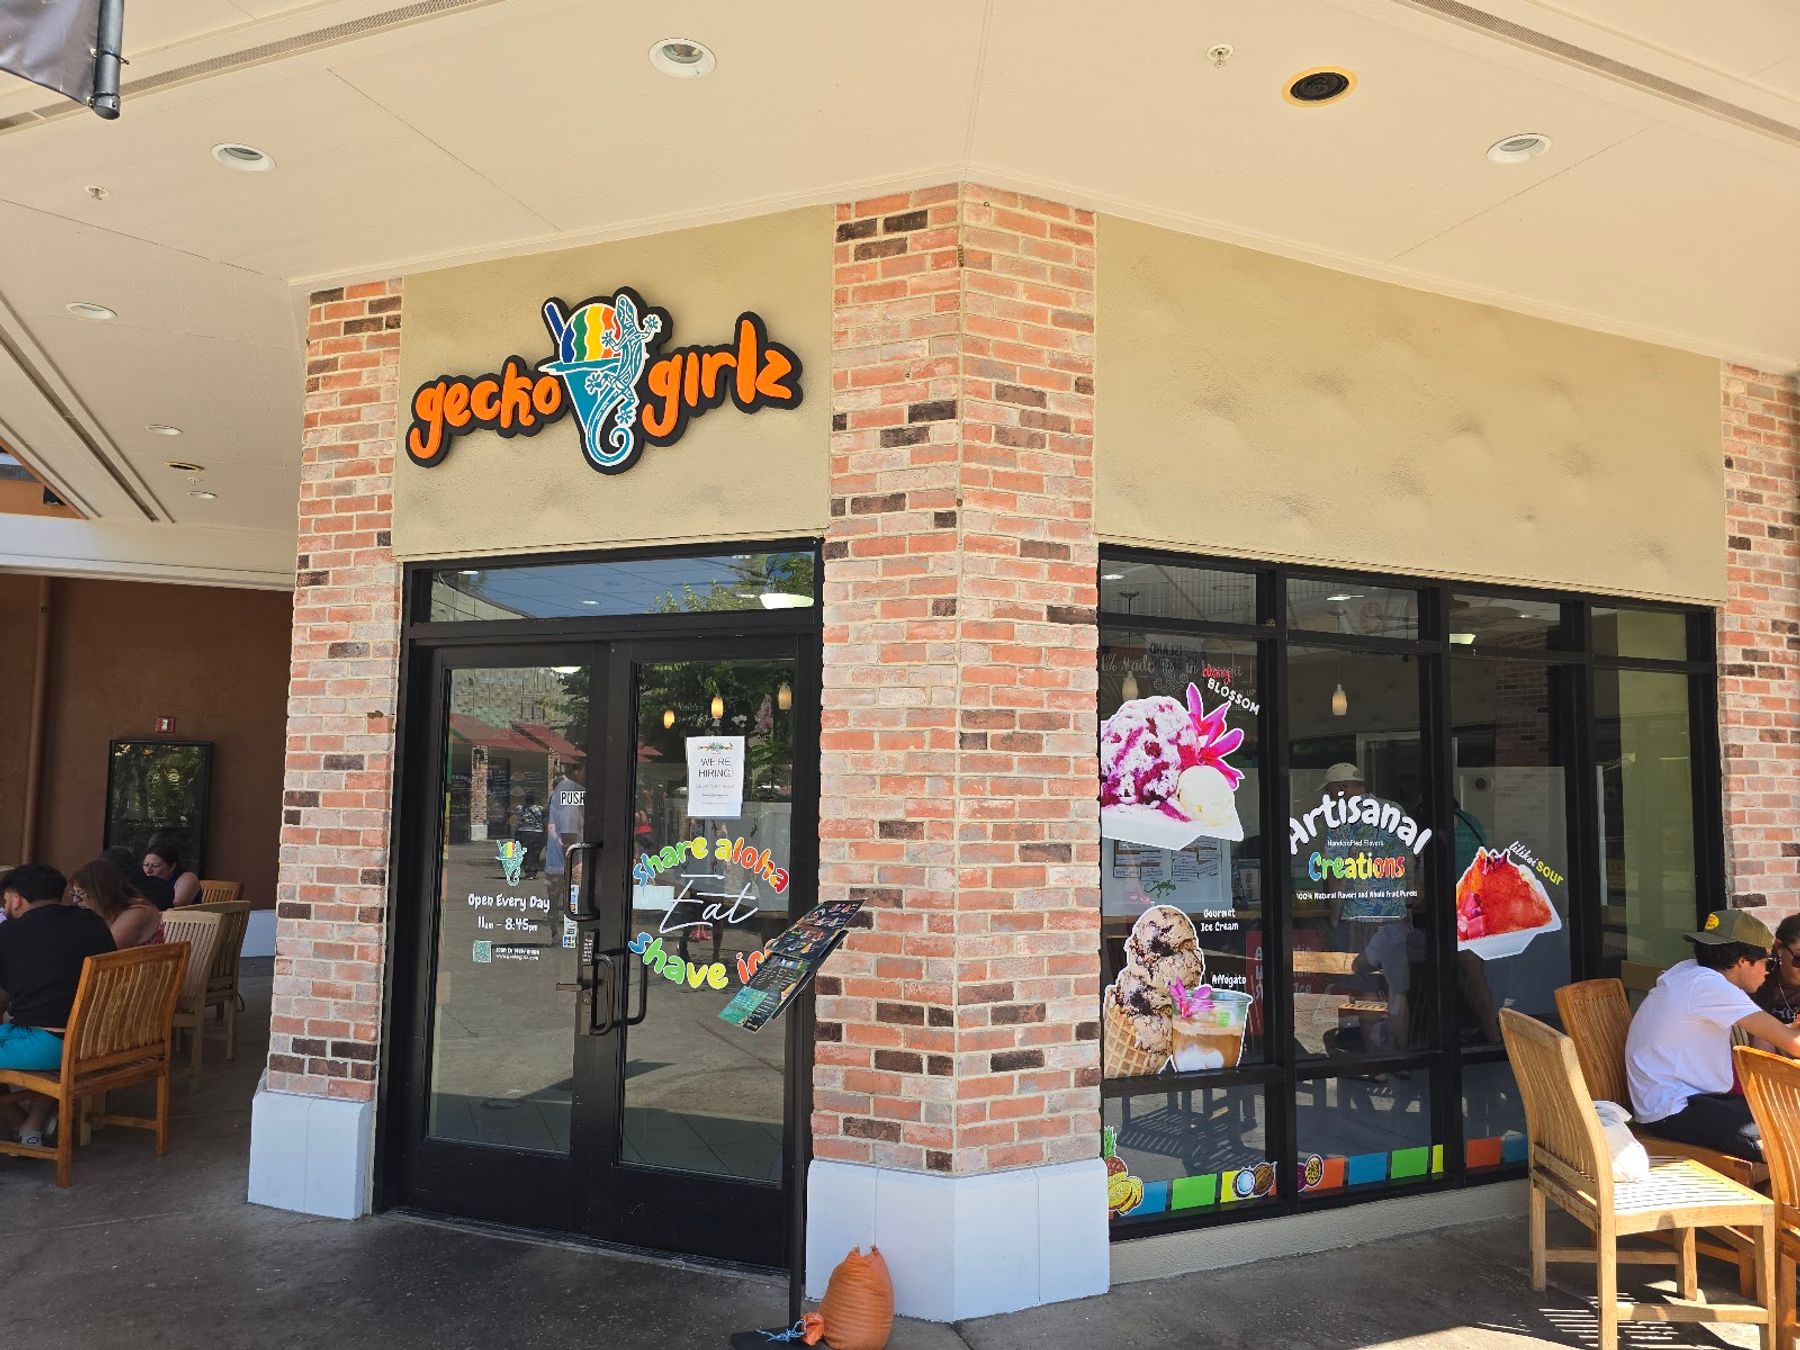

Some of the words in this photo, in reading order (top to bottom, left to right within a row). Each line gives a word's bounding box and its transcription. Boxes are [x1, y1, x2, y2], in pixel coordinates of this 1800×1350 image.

[409, 360, 562, 461] gecko
[642, 319, 794, 438] girlz
[1207, 678, 1261, 716] BLOSSOM
[698, 769, 734, 778] HIRING!
[701, 758, 731, 766] WE'RE
[561, 792, 585, 804] PUSH
[1290, 791, 1433, 855] Artisanal
[633, 836, 708, 888] share
[715, 836, 790, 894] aloha
[1308, 851, 1405, 882] Creations
[1535, 861, 1564, 885] sour
[468, 893, 494, 910] Open
[496, 893, 527, 912] Every
[529, 895, 551, 914] Day
[659, 874, 759, 934] Eat
[1203, 908, 1236, 919] Gourmet
[1200, 922, 1213, 932] Ice
[1215, 922, 1239, 932] Cream
[628, 931, 729, 990] shave
[1211, 974, 1247, 986] Affogato
